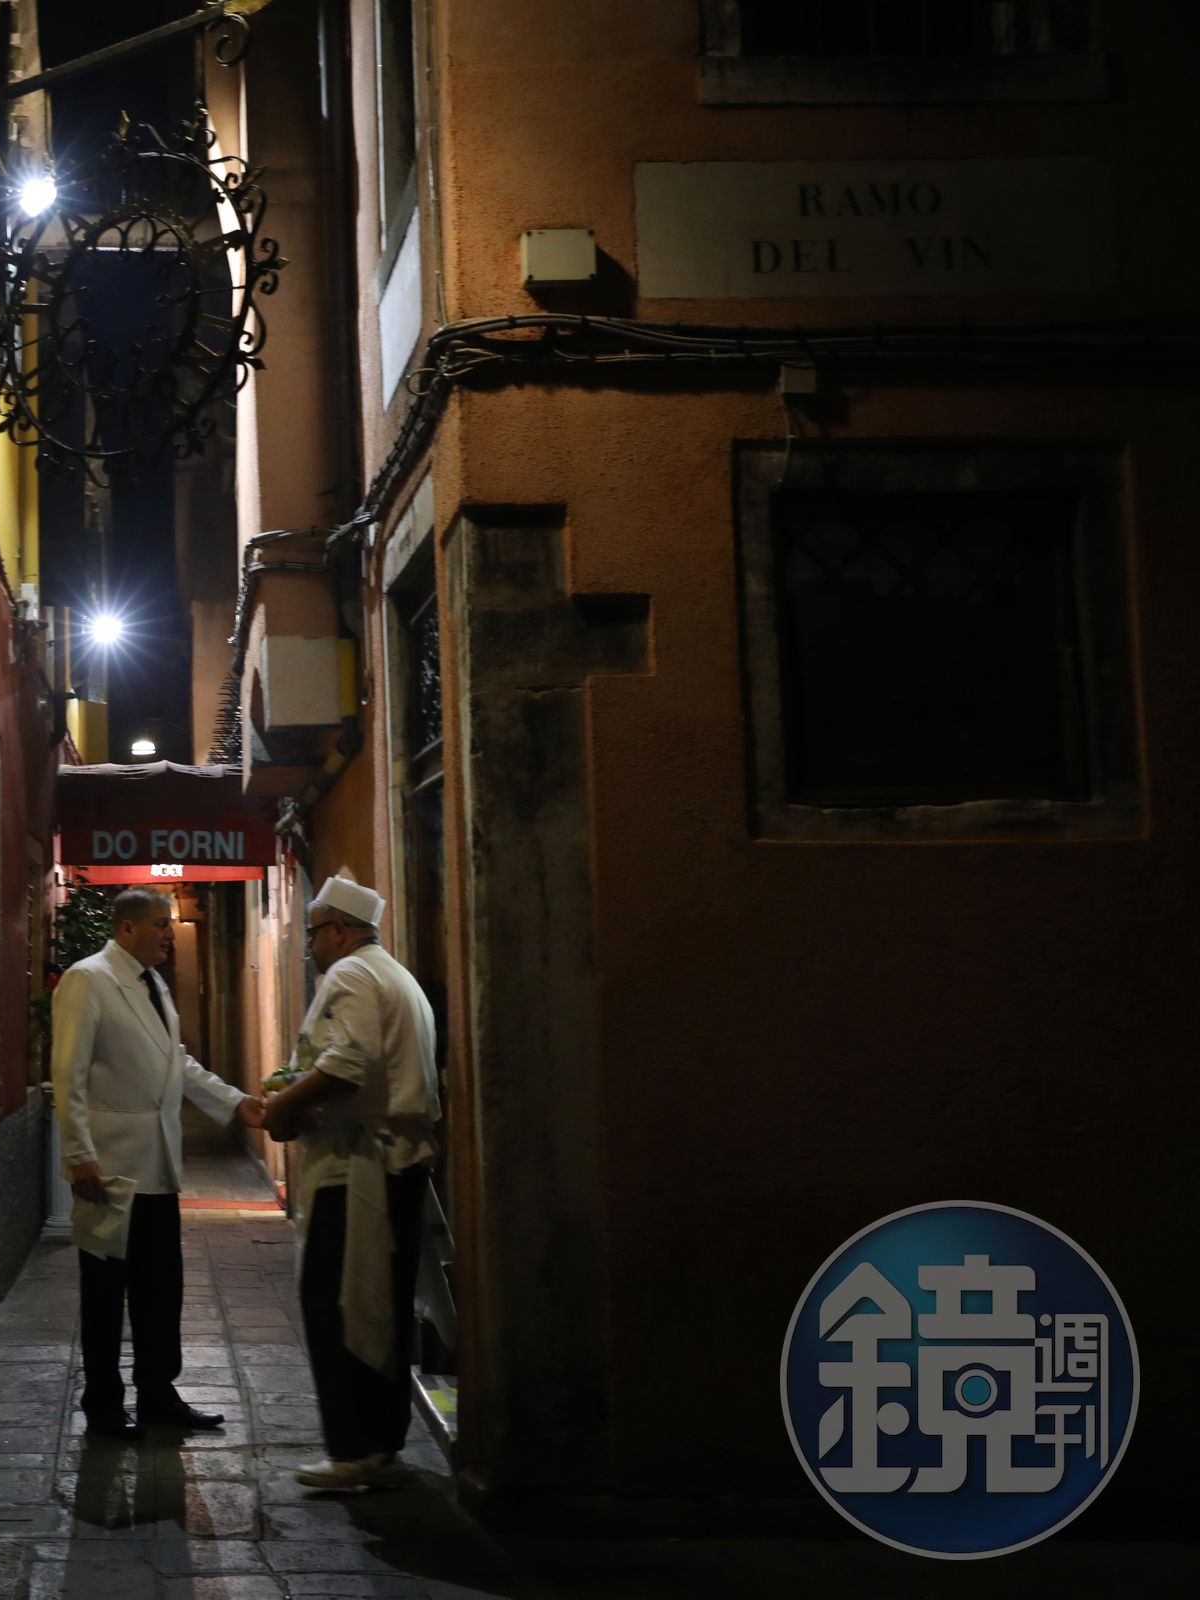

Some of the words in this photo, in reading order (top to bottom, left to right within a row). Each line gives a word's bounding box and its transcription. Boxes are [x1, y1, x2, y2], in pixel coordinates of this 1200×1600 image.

[797, 182, 942, 217] RAMO
[751, 239, 852, 274] DEL
[905, 235, 992, 271] VIN
[92, 829, 138, 860] DO
[151, 829, 244, 860] FORNI
